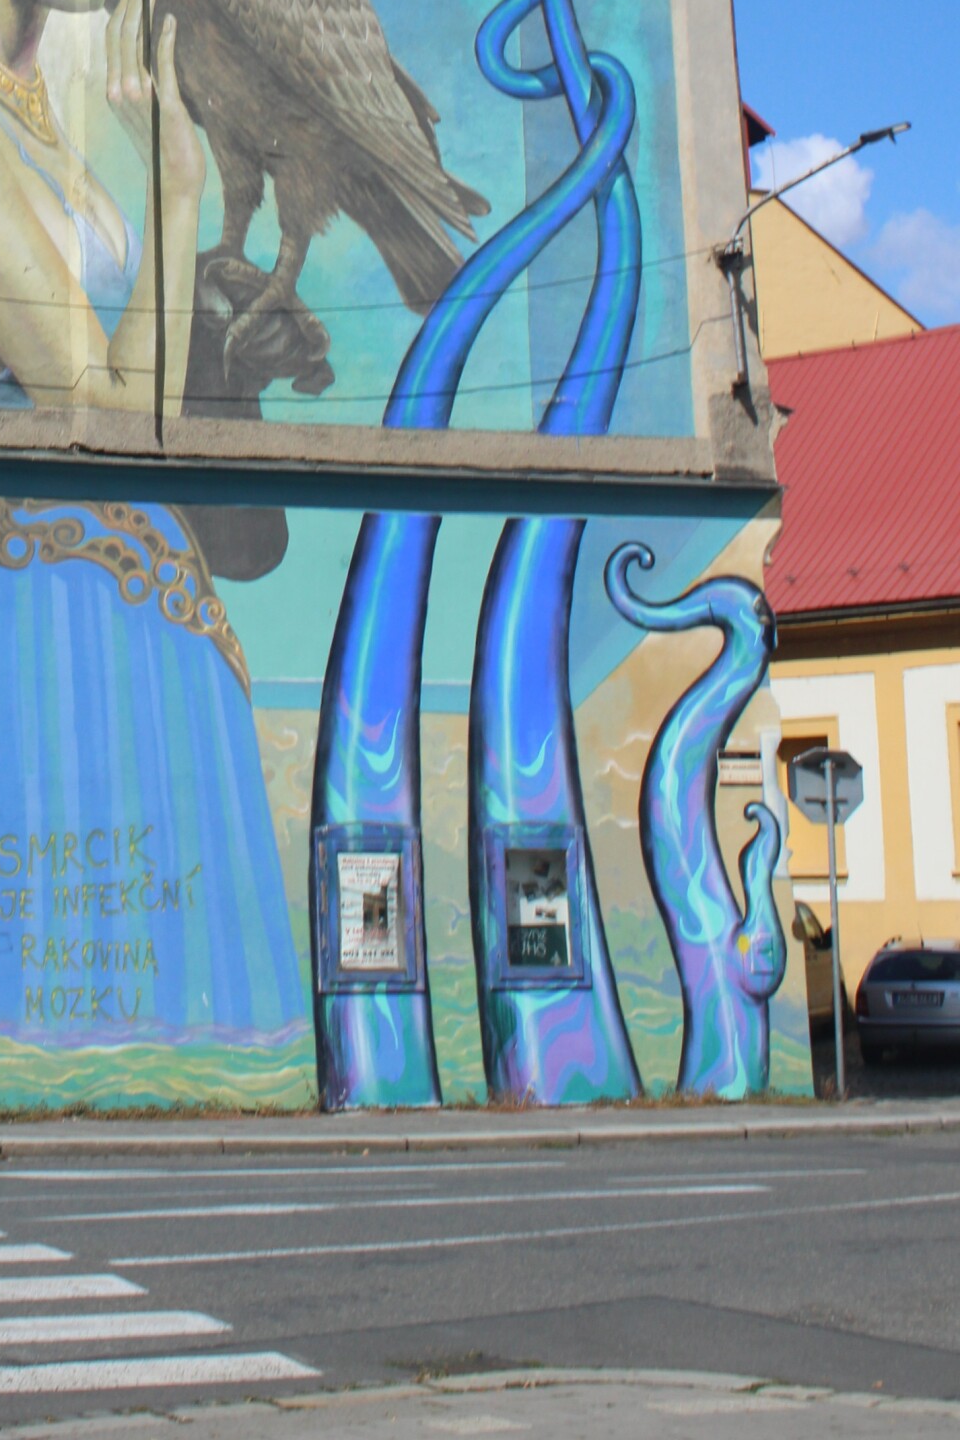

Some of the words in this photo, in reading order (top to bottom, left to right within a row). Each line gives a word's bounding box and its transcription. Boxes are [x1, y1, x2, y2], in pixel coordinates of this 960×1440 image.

[53, 863, 202, 921] INFEKČNÍ
[20, 932, 160, 978] RAKOVINA
[24, 984, 143, 1025] MOZKU
